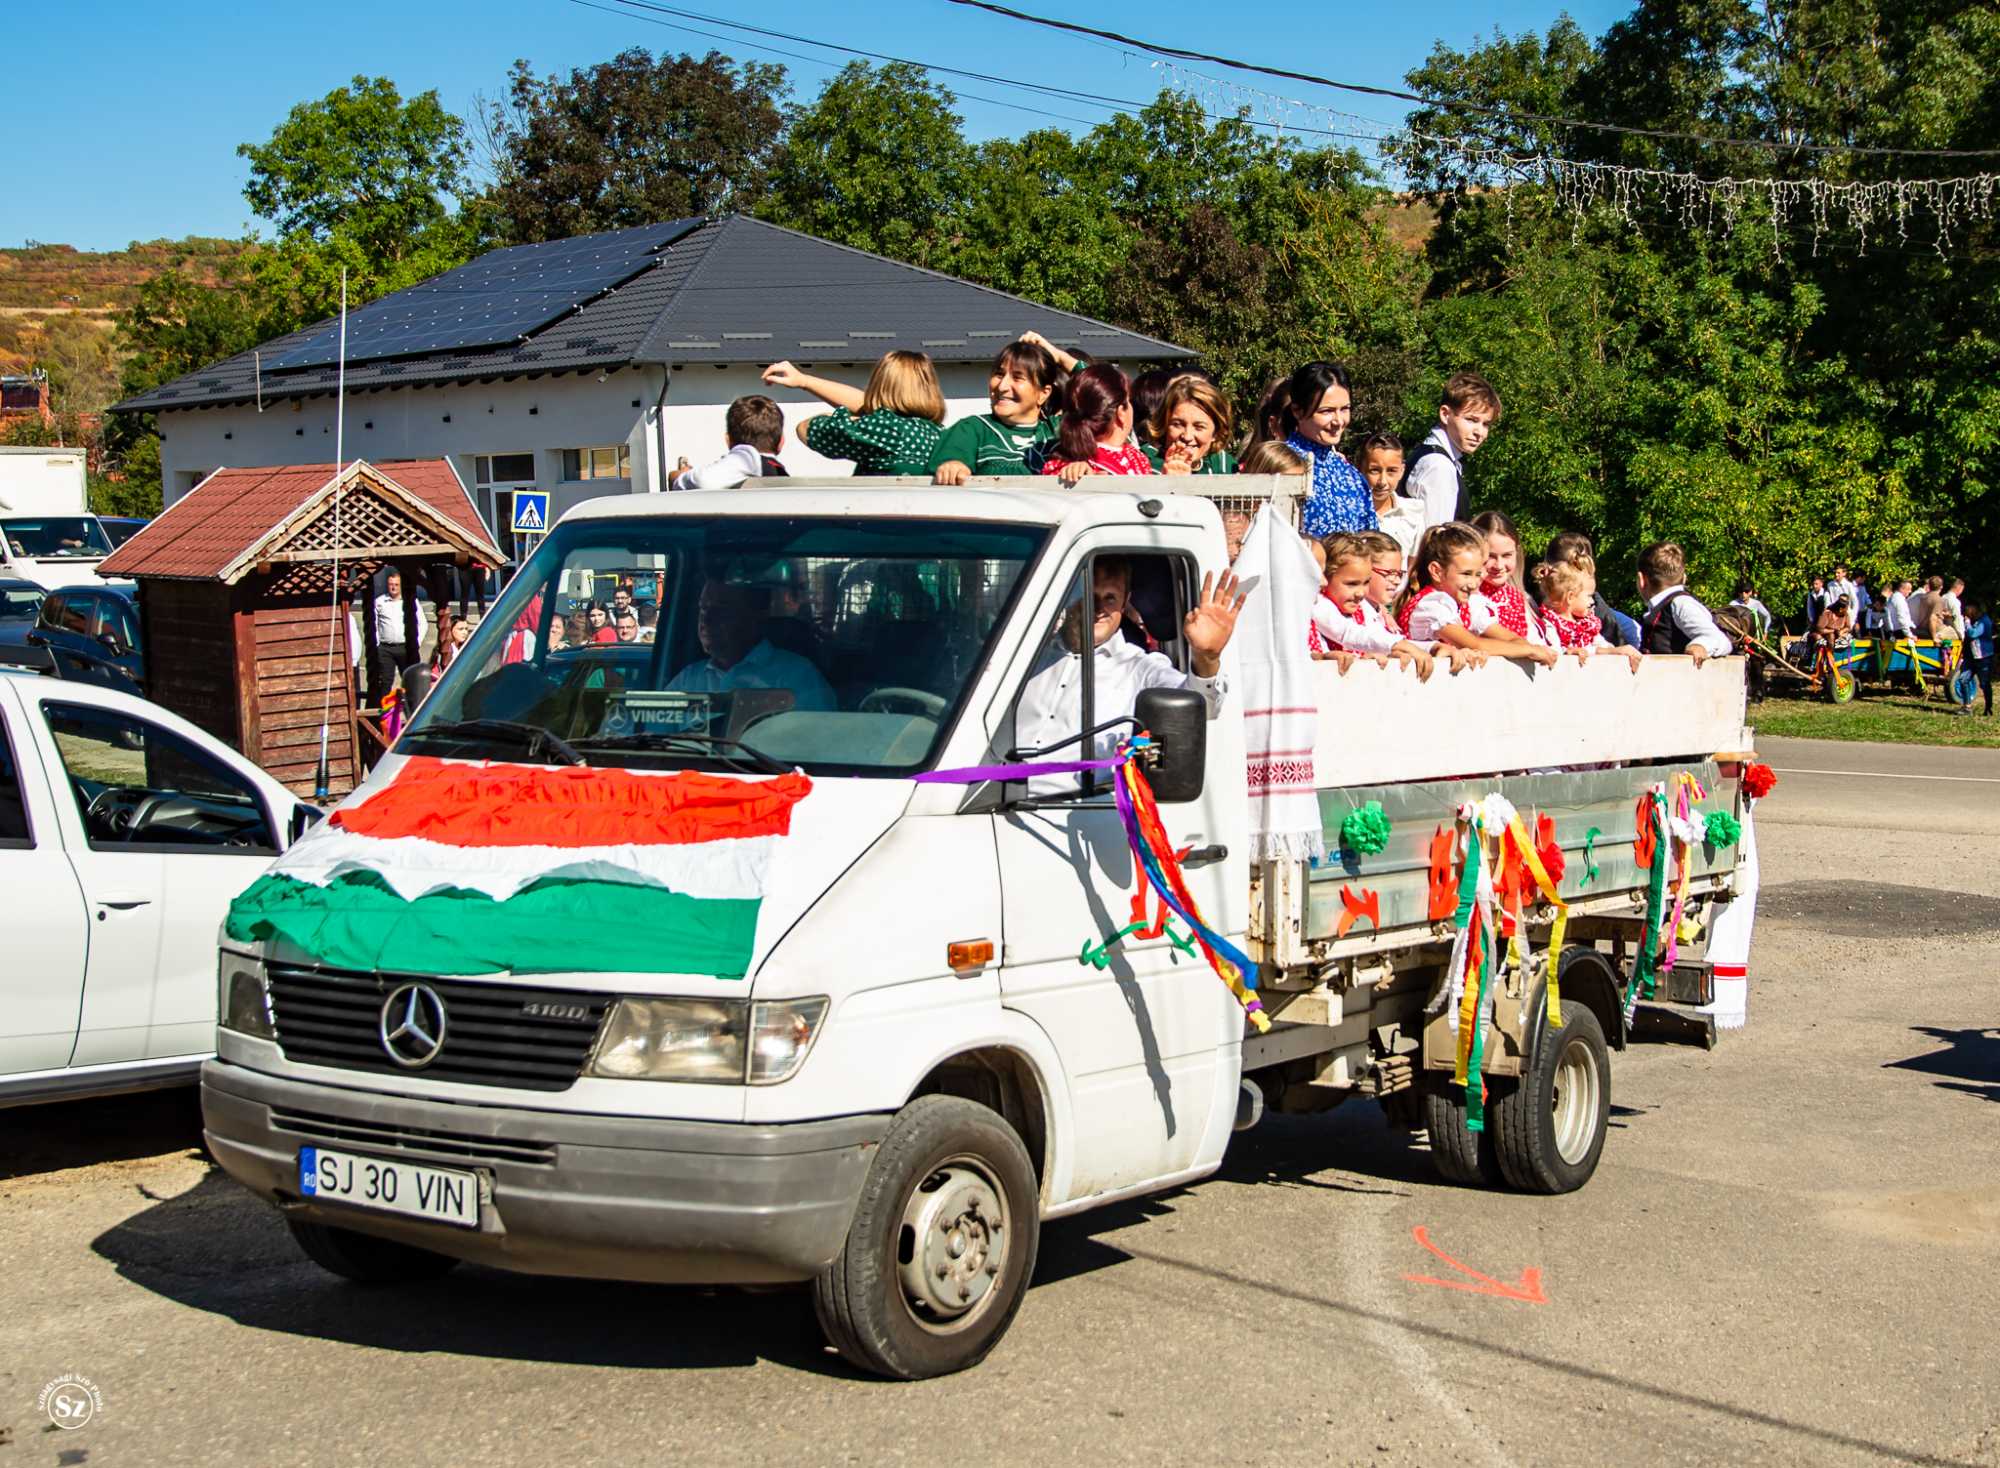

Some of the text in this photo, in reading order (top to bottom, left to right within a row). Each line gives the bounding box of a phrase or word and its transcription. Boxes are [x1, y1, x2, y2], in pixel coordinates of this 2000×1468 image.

[631, 709, 685, 724] VINCZE
[522, 1003, 585, 1019] 410D
[303, 1172, 316, 1188] RO
[320, 1156, 463, 1215] SJ 30 VIN
